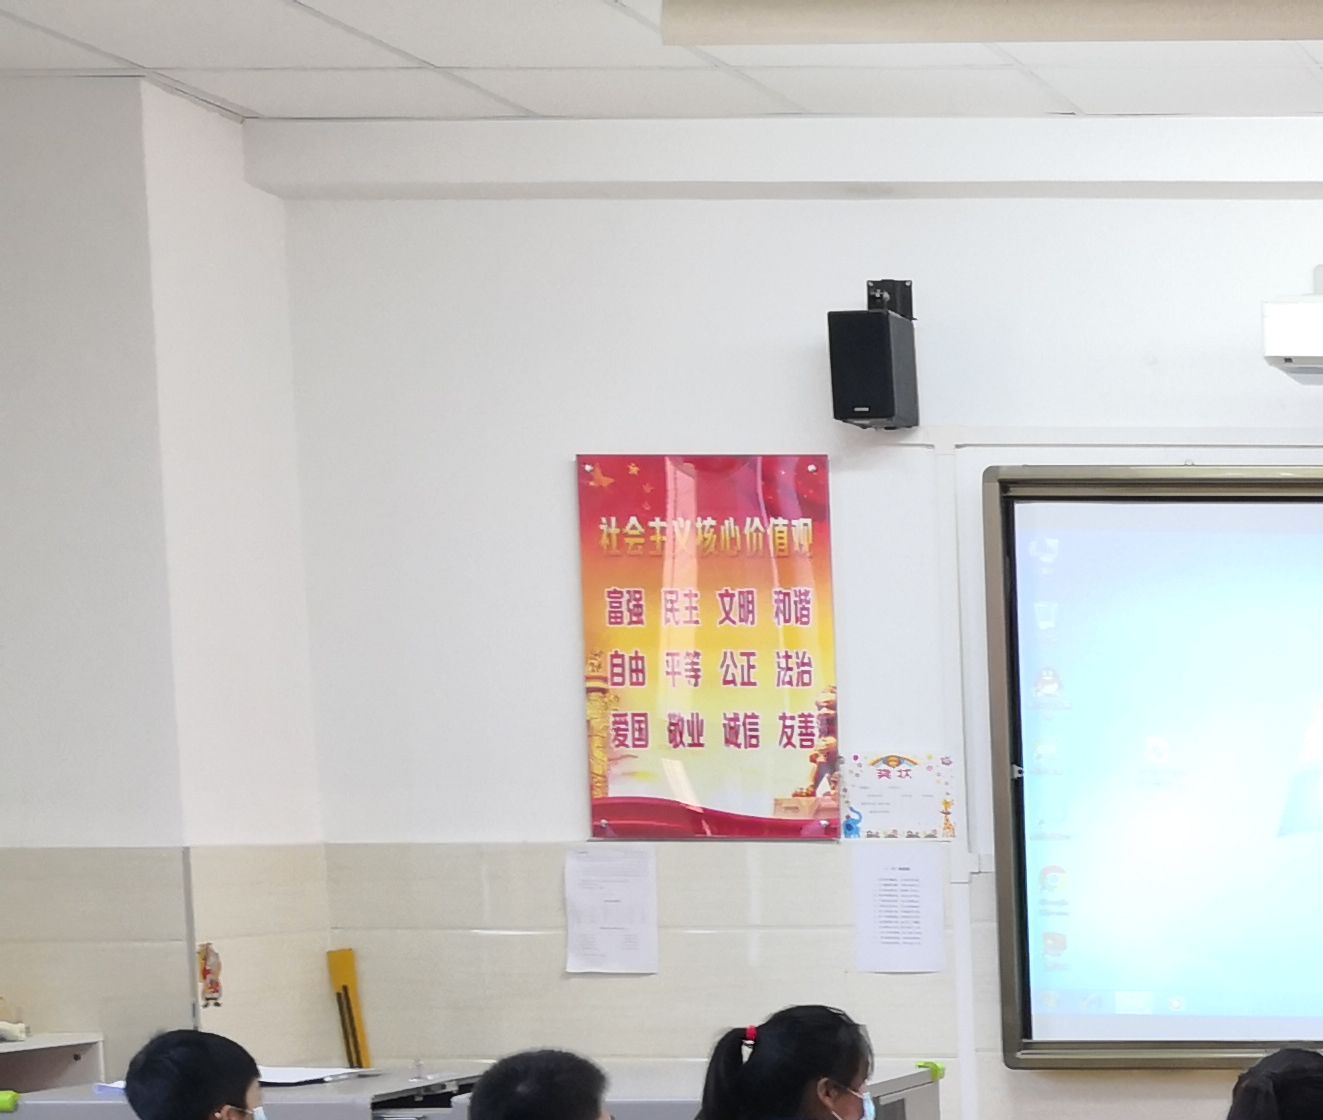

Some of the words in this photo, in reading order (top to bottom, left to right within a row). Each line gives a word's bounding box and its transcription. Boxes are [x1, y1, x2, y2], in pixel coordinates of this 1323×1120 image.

[599, 516, 813, 556] 社会主义核心价值观
[606, 588, 645, 625] 富强
[663, 589, 700, 625] 民主
[718, 588, 755, 625] 文明
[774, 589, 811, 625] 和谐
[609, 650, 646, 687] 自由
[665, 651, 702, 687] 平等
[720, 650, 757, 687] 公正
[776, 650, 812, 687] 法治
[611, 712, 649, 749] 爱国
[667, 712, 704, 749] 敬业
[722, 712, 760, 749] 诚信
[778, 712, 816, 749] 友善
